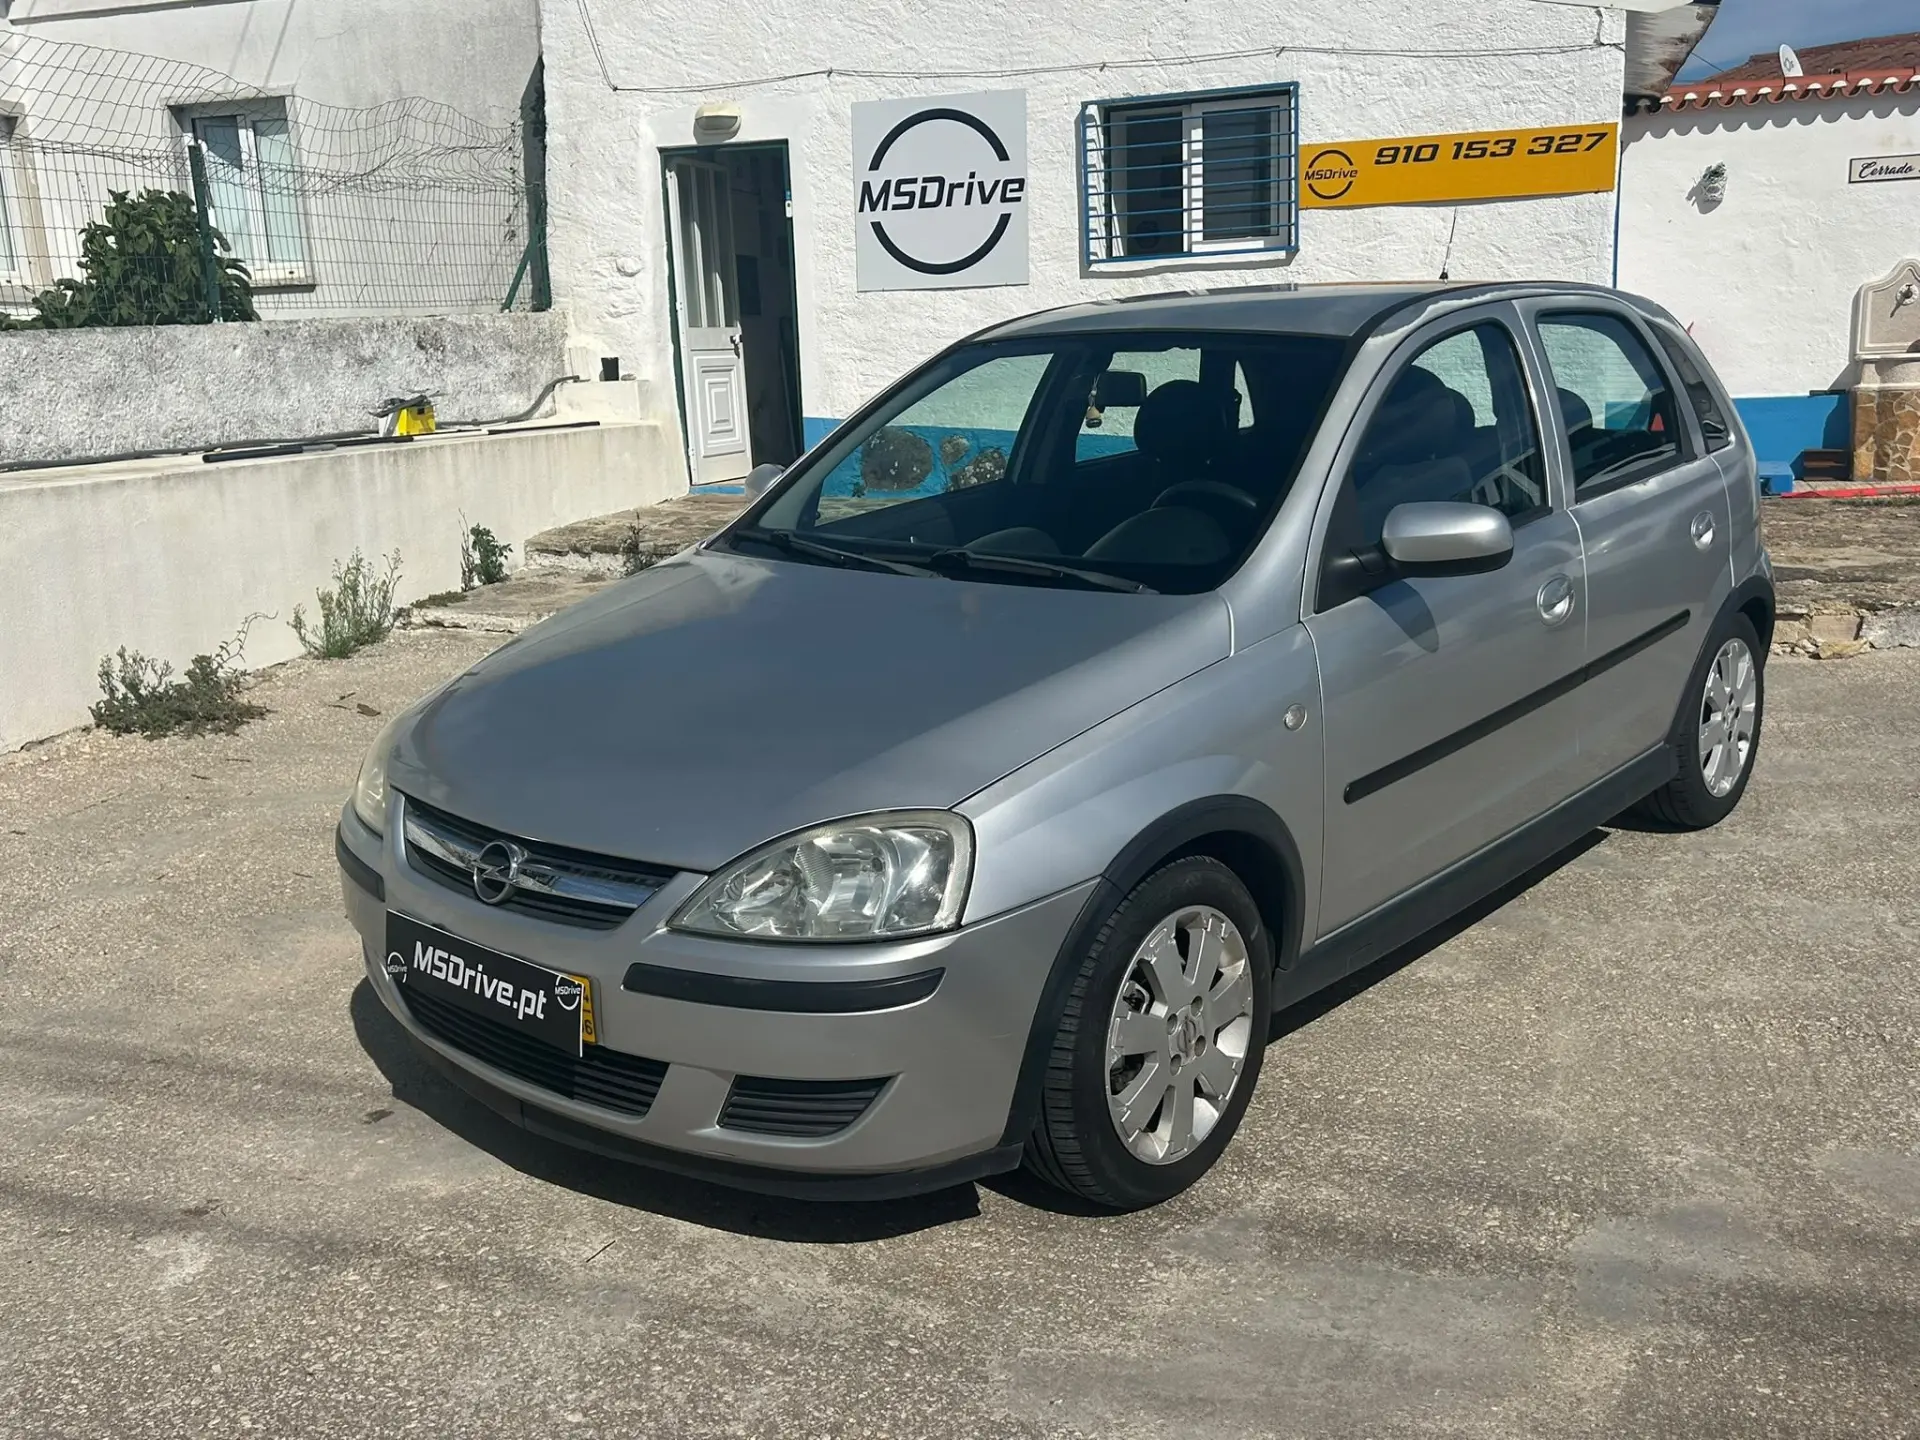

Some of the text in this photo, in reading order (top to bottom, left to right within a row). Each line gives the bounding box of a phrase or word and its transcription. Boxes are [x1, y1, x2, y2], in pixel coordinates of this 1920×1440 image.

[1374, 132, 1608, 165] 910 153 327
[1304, 167, 1358, 181] MSDrive
[1858, 161, 1915, 178] Cerrado
[858, 171, 1026, 213] MSDrive
[413, 940, 547, 1020] MSDrive.pt
[555, 985, 580, 995] MSDrive
